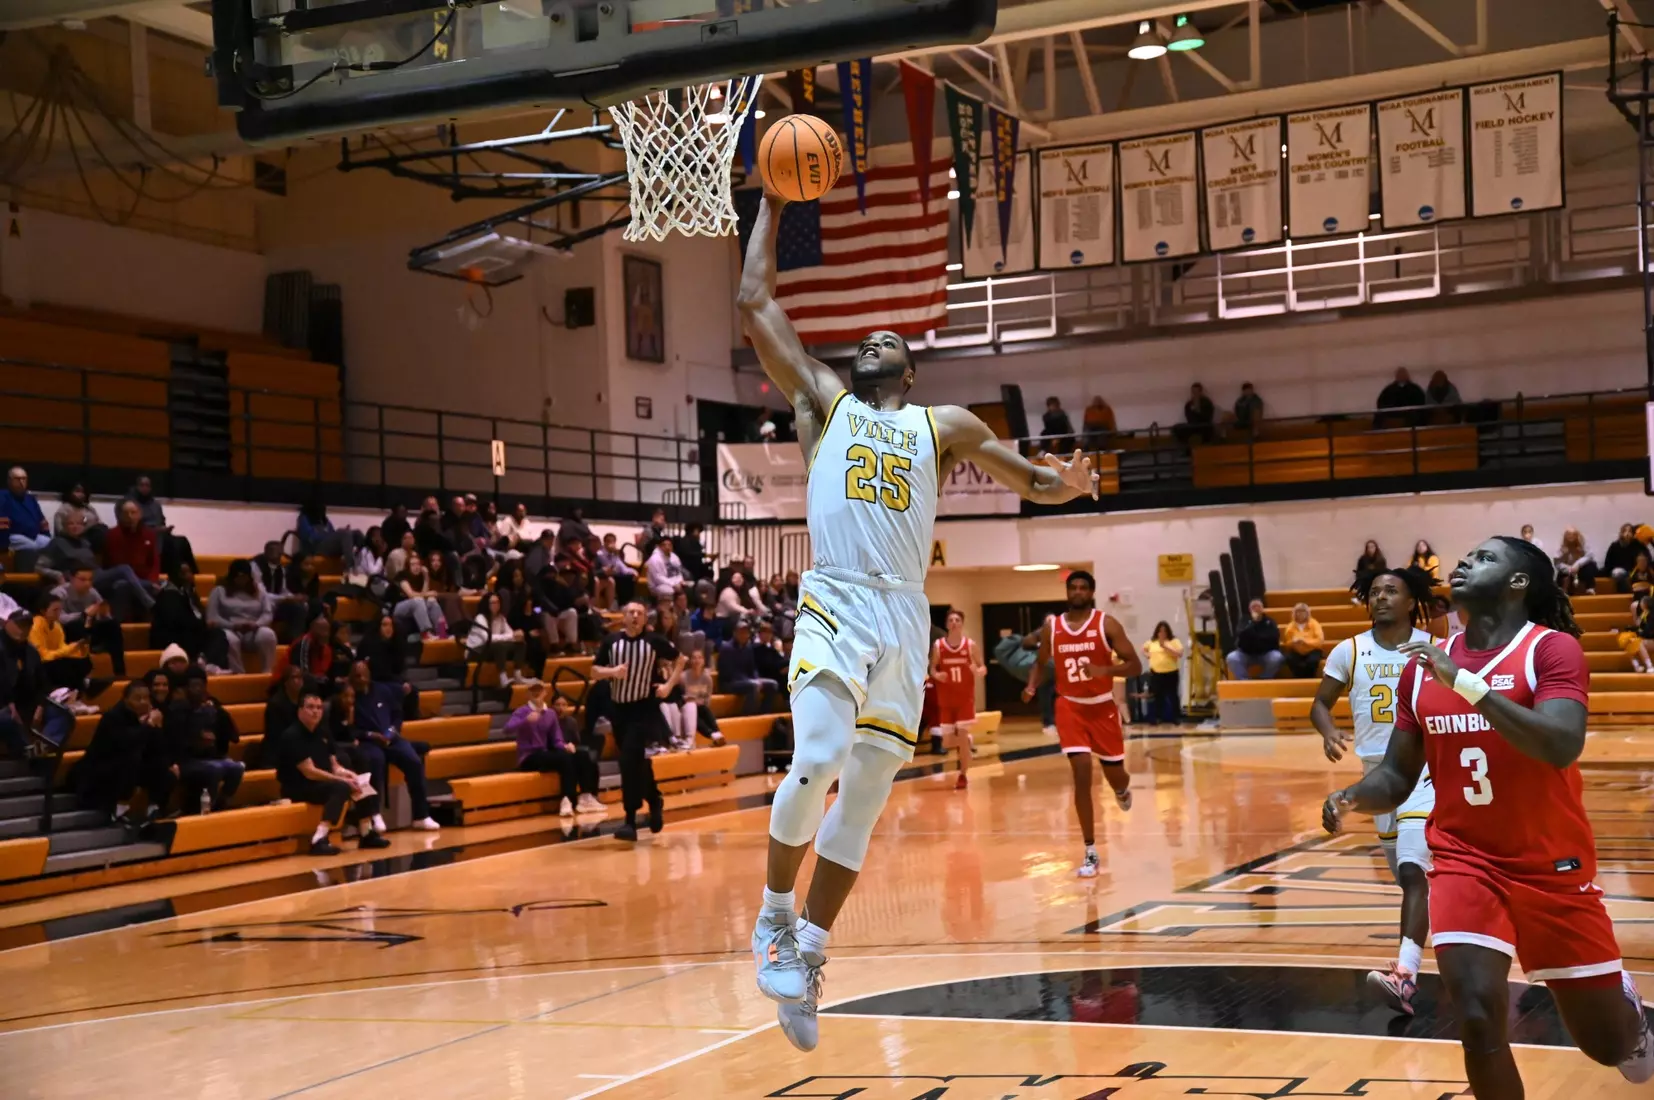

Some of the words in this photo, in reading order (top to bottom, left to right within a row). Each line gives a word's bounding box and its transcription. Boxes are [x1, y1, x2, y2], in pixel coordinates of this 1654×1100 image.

[1499, 78, 1555, 92] TOURNAMENT
[1403, 92, 1461, 108] TOURNAMENT
[1312, 107, 1368, 121] TOURNAMENT
[1475, 118, 1505, 131] FIELD
[1508, 111, 1555, 126] HOCKEY
[1395, 137, 1446, 152] FOOTBALL
[806, 152, 821, 184] EVO
[1290, 162, 1321, 173] CROSS
[1324, 156, 1368, 170] COUNTRY
[847, 412, 918, 455] VILLE
[845, 443, 912, 513] 25
[930, 540, 945, 568] A
[950, 665, 962, 683] 11
[1491, 677, 1515, 688] PSAC
[1369, 684, 1399, 724] 2
[1425, 713, 1495, 735] EDINBO
[1459, 746, 1494, 806] 3
